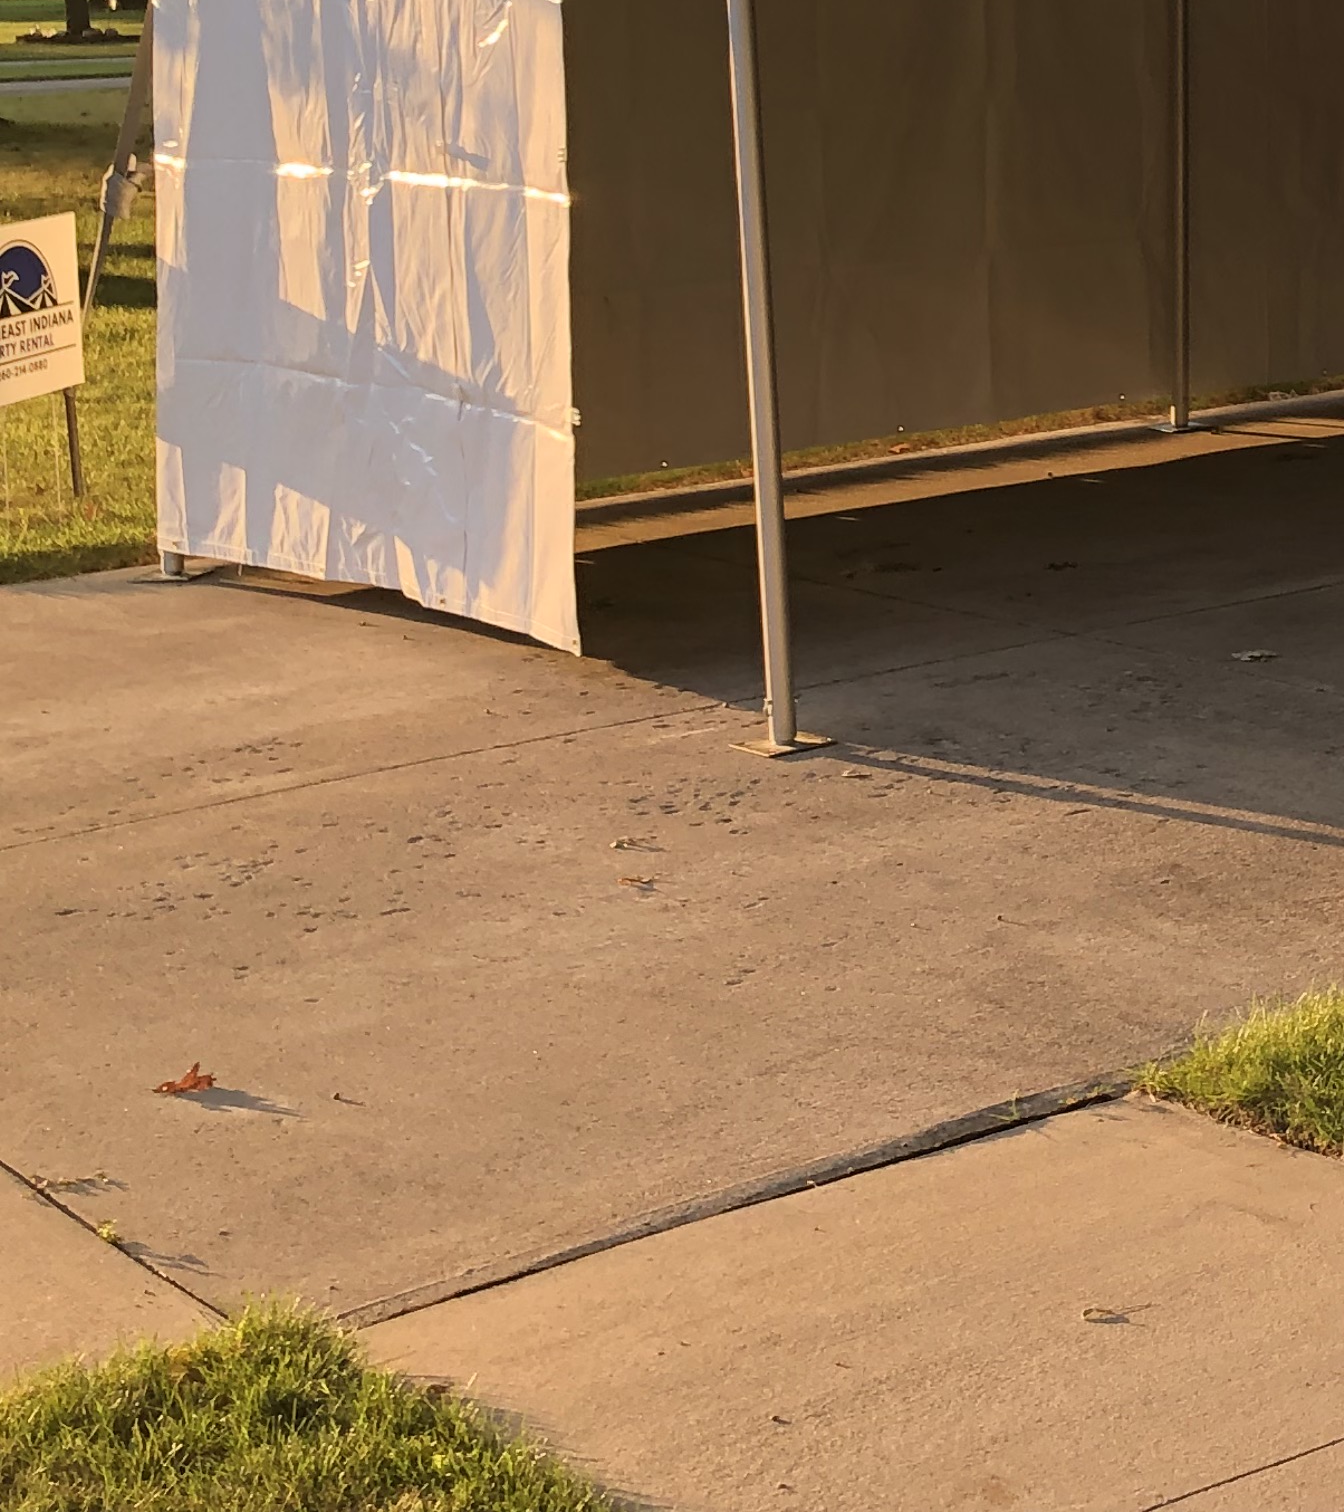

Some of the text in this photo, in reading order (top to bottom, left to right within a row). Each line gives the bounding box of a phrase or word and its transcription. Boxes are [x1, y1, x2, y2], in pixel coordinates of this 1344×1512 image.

[0, 309, 74, 340] EAST INDIANA
[0, 333, 55, 359] RTY RENTAL
